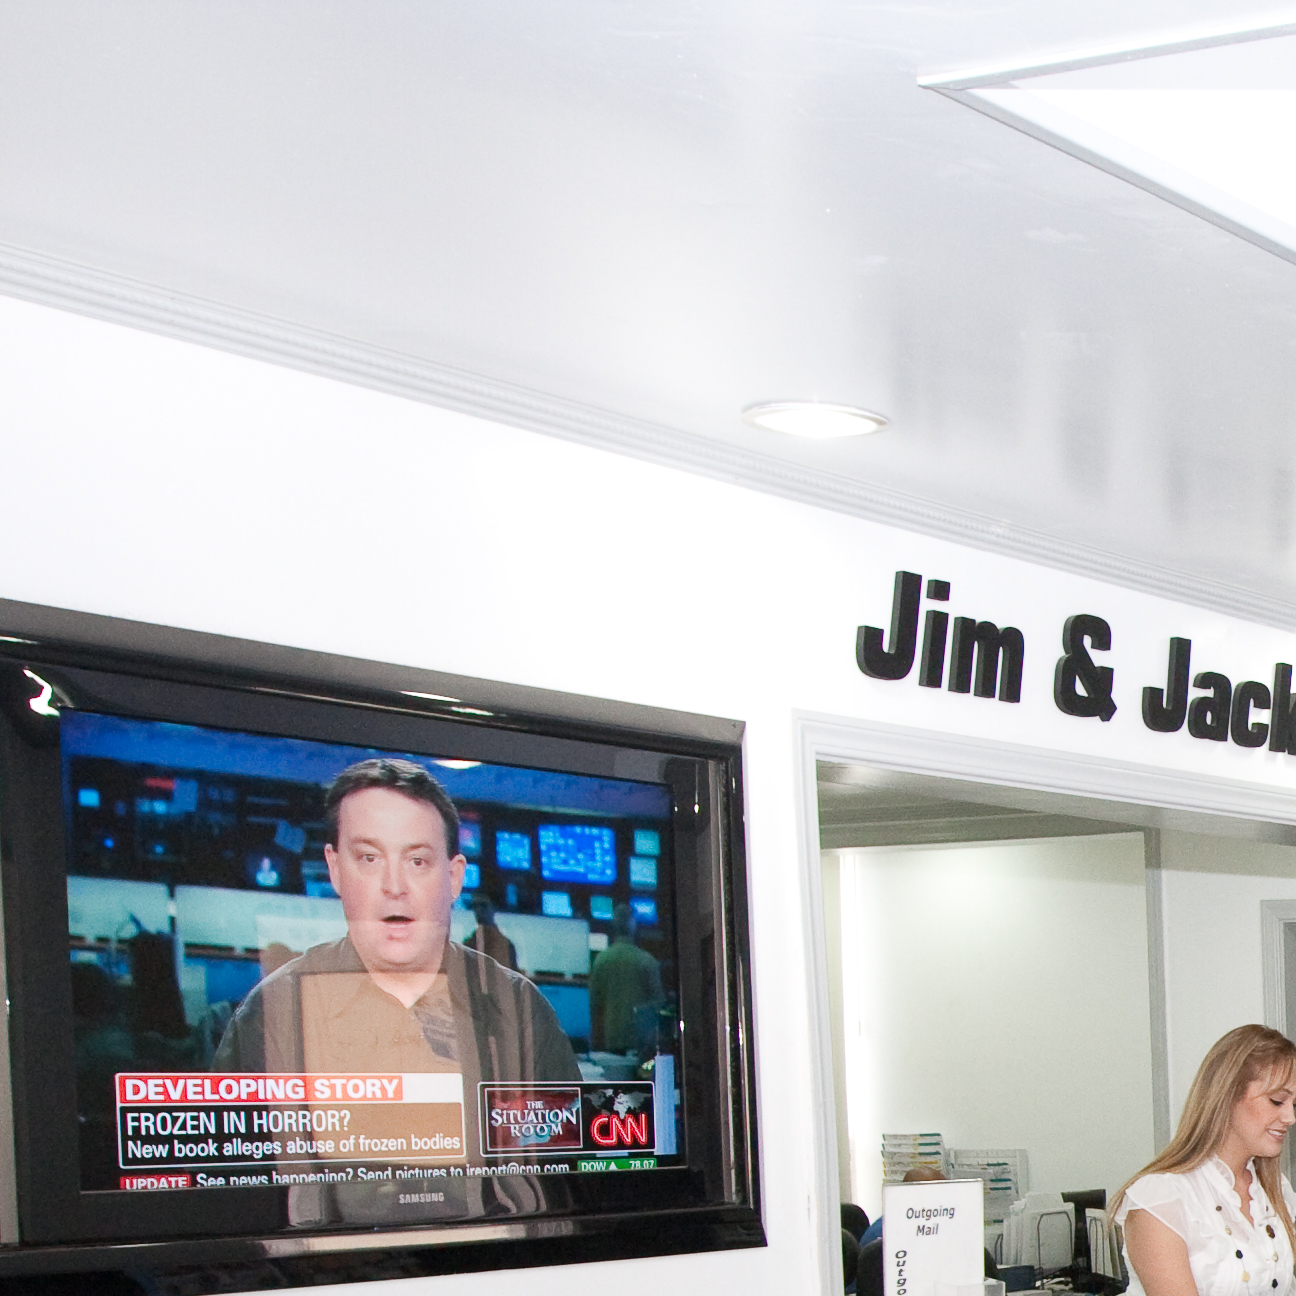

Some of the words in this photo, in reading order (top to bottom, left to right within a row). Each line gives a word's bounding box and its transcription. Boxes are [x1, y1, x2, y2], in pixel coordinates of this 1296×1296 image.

[856, 570, 1025, 703] Jim
[1054, 613, 1118, 722] &
[125, 1078, 306, 1102] DEVELOPING
[313, 1078, 400, 1100] STORY
[526, 1100, 544, 1109] THE
[126, 1111, 216, 1136] FROZEN
[223, 1110, 246, 1135] IN
[252, 1109, 351, 1134] HORROR?
[490, 1108, 578, 1127] SITUATION
[510, 1123, 563, 1138] ROOM
[589, 1112, 649, 1146] CNN
[127, 1140, 169, 1159] New
[173, 1138, 219, 1158] book
[222, 1137, 282, 1159] alleges
[286, 1136, 335, 1155] abuse
[338, 1135, 358, 1154] of
[358, 1134, 407, 1152] frozen
[410, 1132, 461, 1150] bodies
[581, 1161, 606, 1171] DOW
[125, 1176, 189, 1190] UPDATE
[196, 1172, 227, 1186] See
[229, 1172, 270, 1186] news
[357, 1166, 393, 1181] Send
[449, 1164, 463, 1178] to
[398, 1192, 444, 1204] SAMSUNG
[906, 1206, 955, 1221] Outgoing
[916, 1223, 939, 1237] Mail
